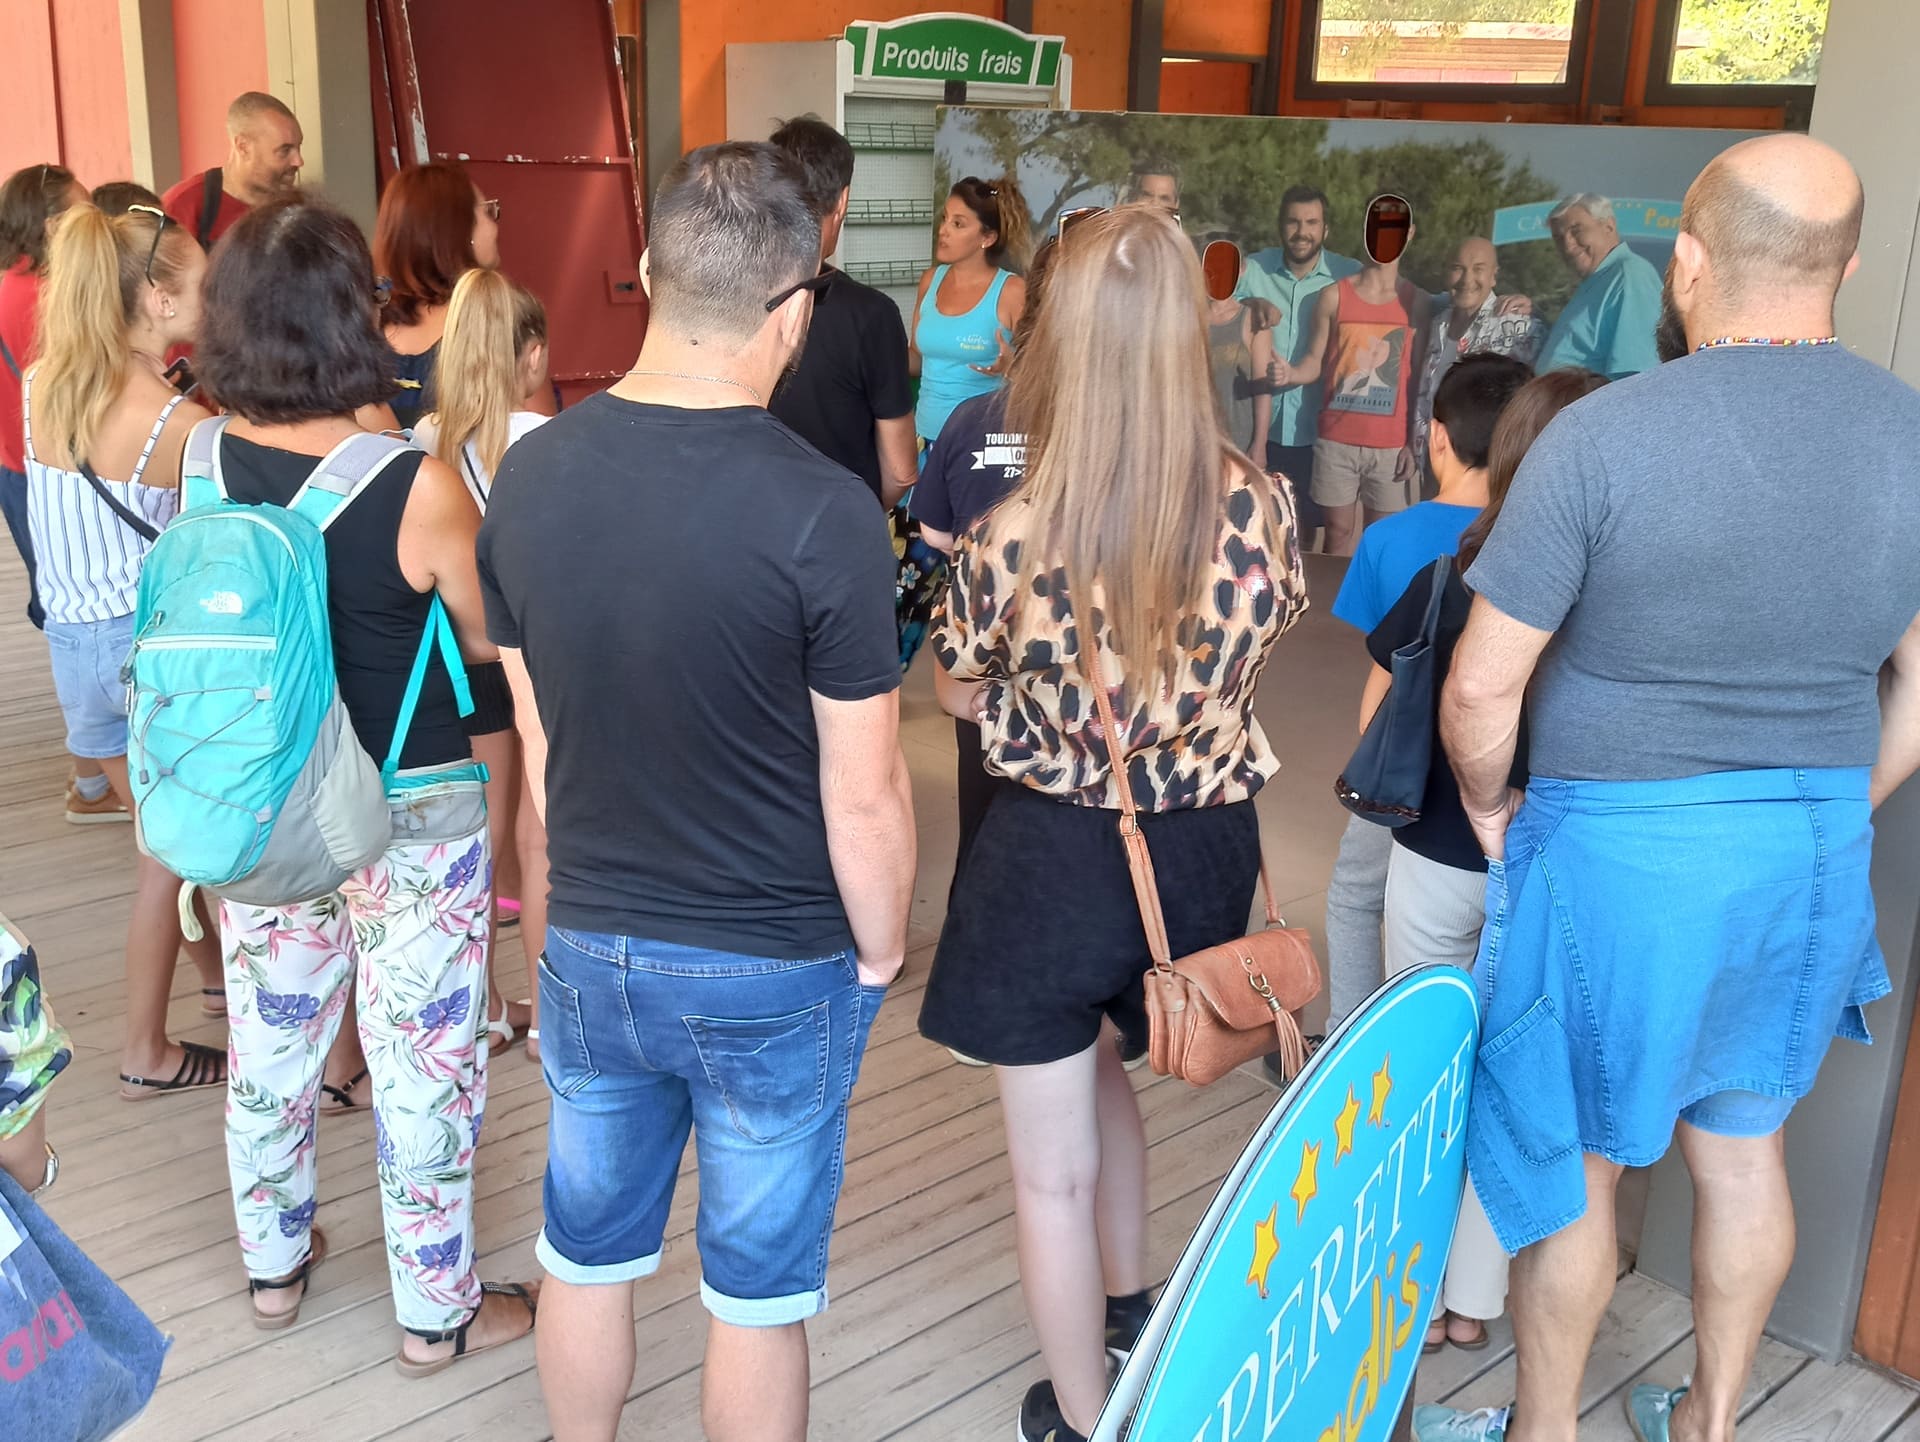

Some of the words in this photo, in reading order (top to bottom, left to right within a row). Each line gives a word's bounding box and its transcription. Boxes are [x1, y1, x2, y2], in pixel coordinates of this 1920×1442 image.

[882, 42, 969, 72] Produits
[978, 49, 1023, 75] frais
[1190, 1029, 1474, 1442] PERETTE
